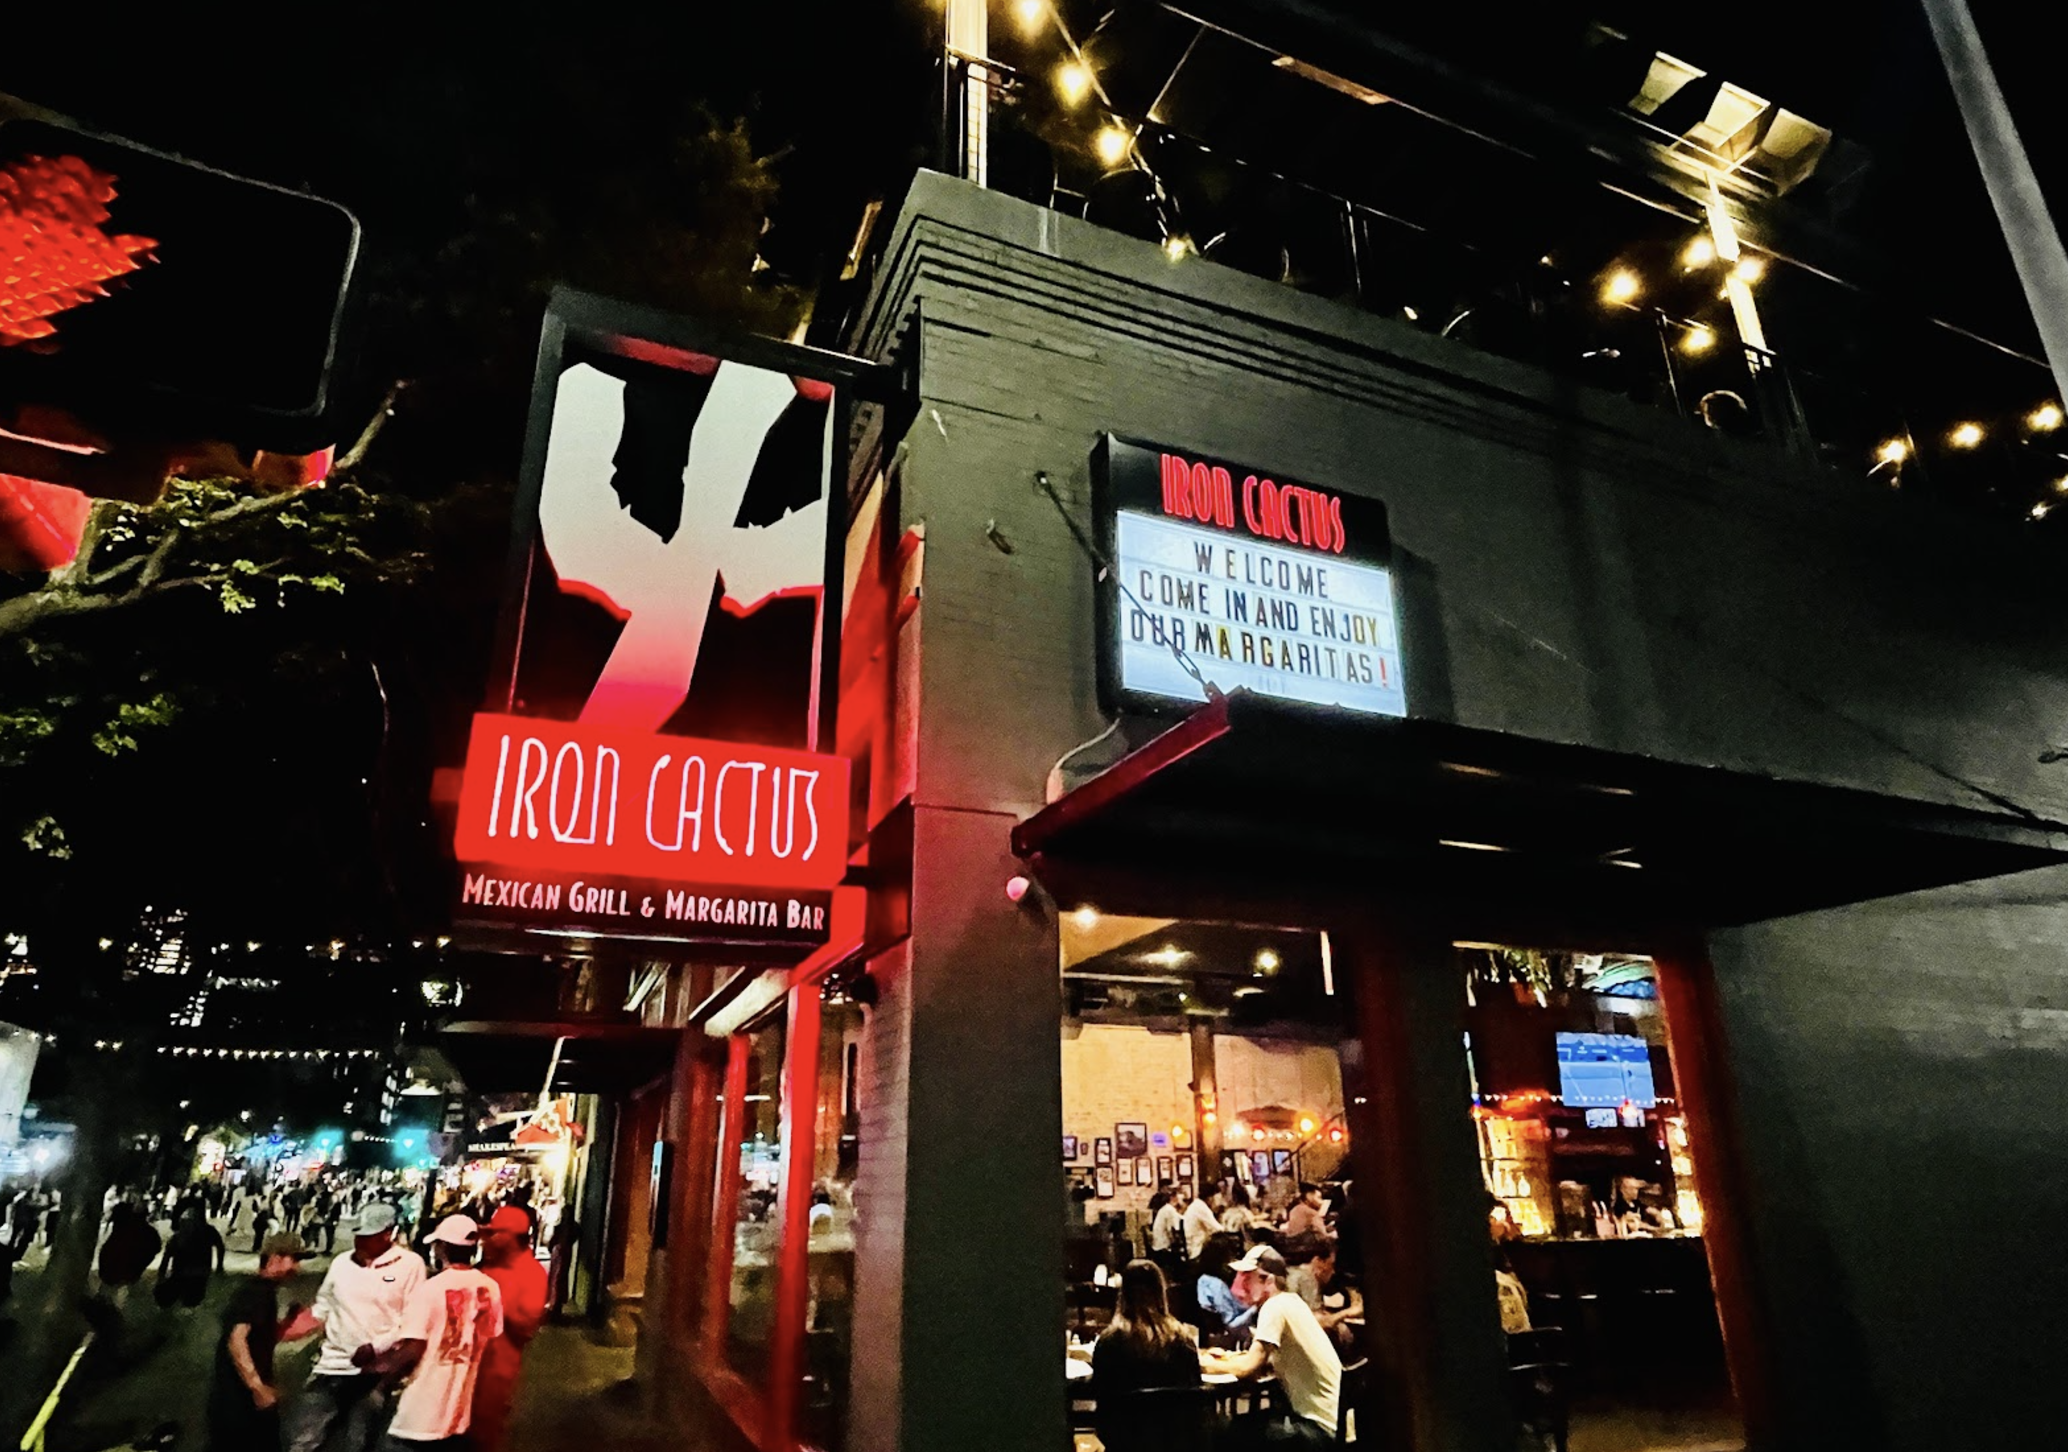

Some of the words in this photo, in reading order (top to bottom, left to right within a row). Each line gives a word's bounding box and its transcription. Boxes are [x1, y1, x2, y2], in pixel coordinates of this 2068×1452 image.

[1161, 453, 1235, 528] IRON
[1243, 475, 1345, 554] CACTUS
[1194, 541, 1328, 598] WELCOME
[1131, 609, 1185, 651] OUR
[1140, 570, 1209, 615] COME
[1225, 588, 1248, 623] IN
[1256, 597, 1298, 631] AND
[1310, 606, 1377, 646] ENJOY
[488, 735, 620, 846] IRON
[645, 755, 819, 861] CACTUS
[640, 896, 655, 918] &
